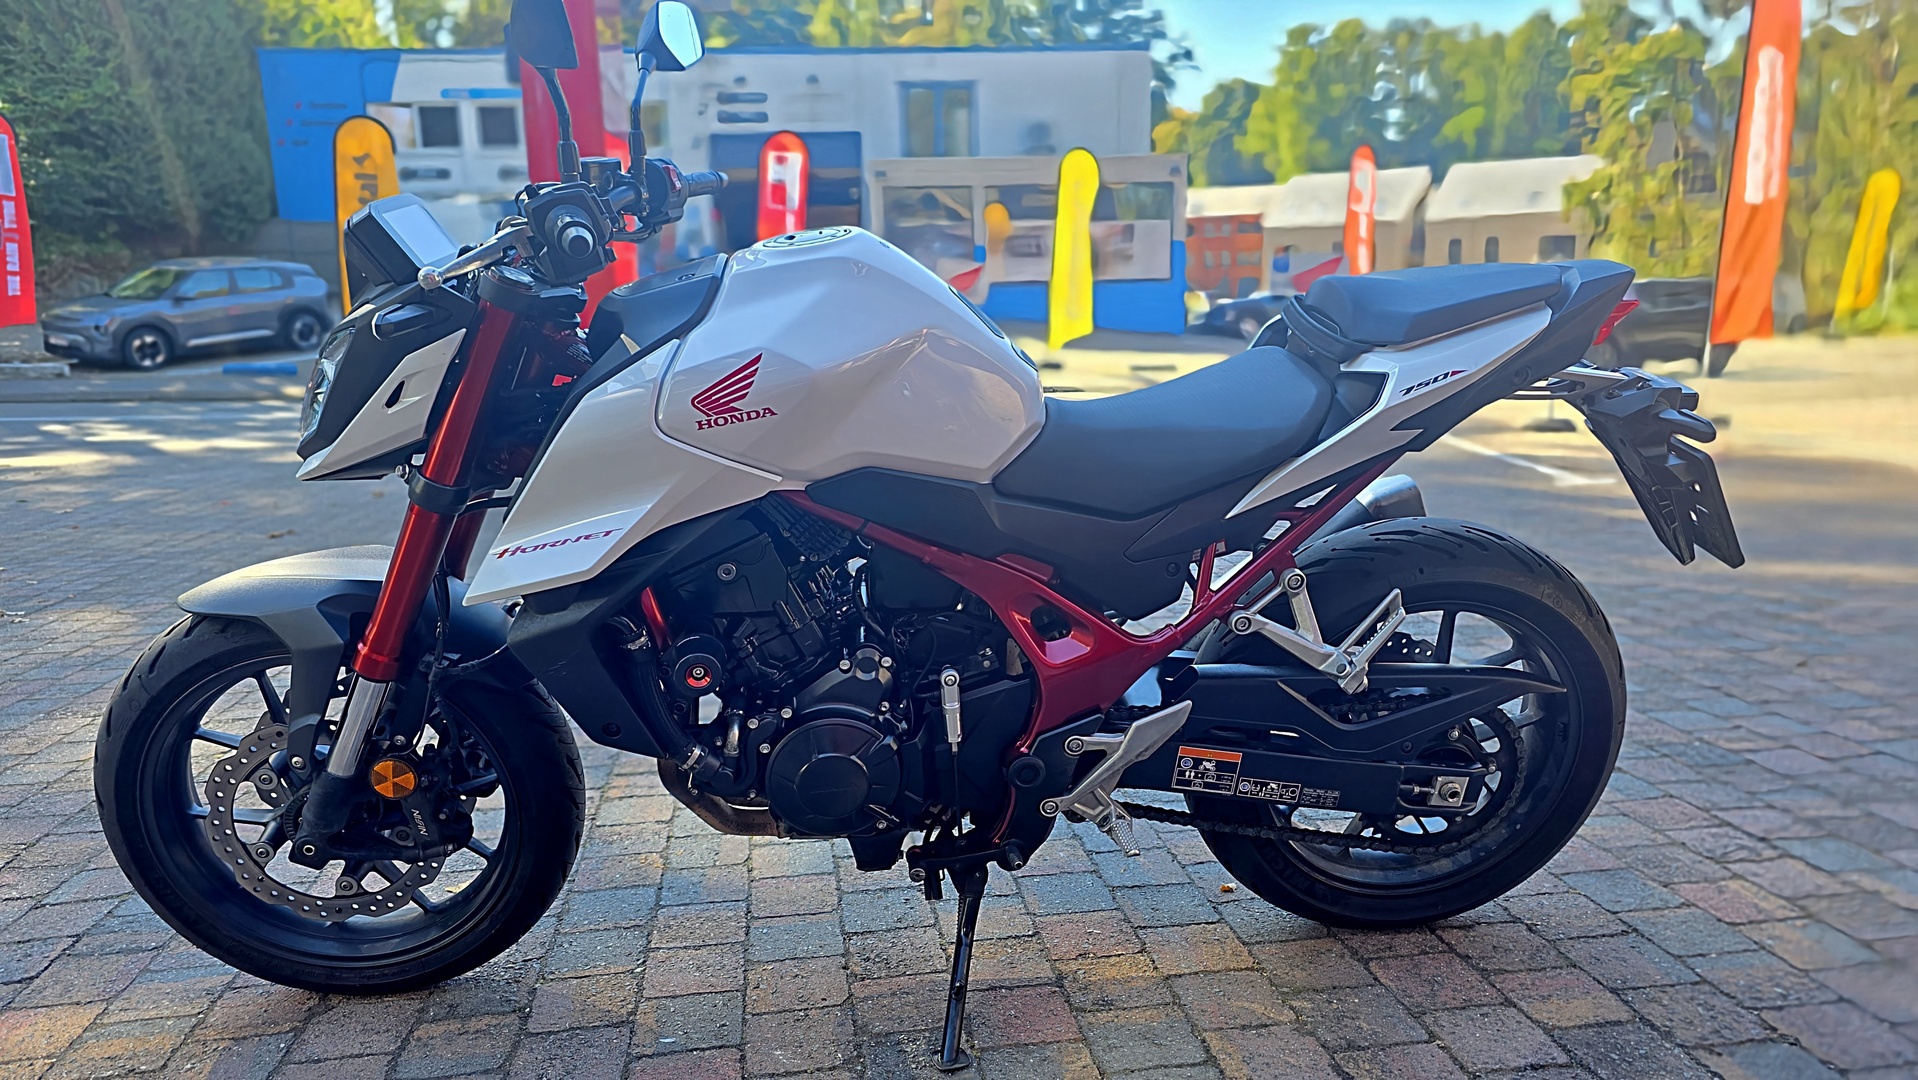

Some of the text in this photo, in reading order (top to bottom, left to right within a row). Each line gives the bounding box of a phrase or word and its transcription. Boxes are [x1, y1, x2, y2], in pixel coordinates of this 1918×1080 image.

[1398, 371, 1451, 397] 750
[695, 406, 778, 431] HONDA
[491, 527, 624, 559] HORNET
[411, 808, 428, 836] NISSIN
